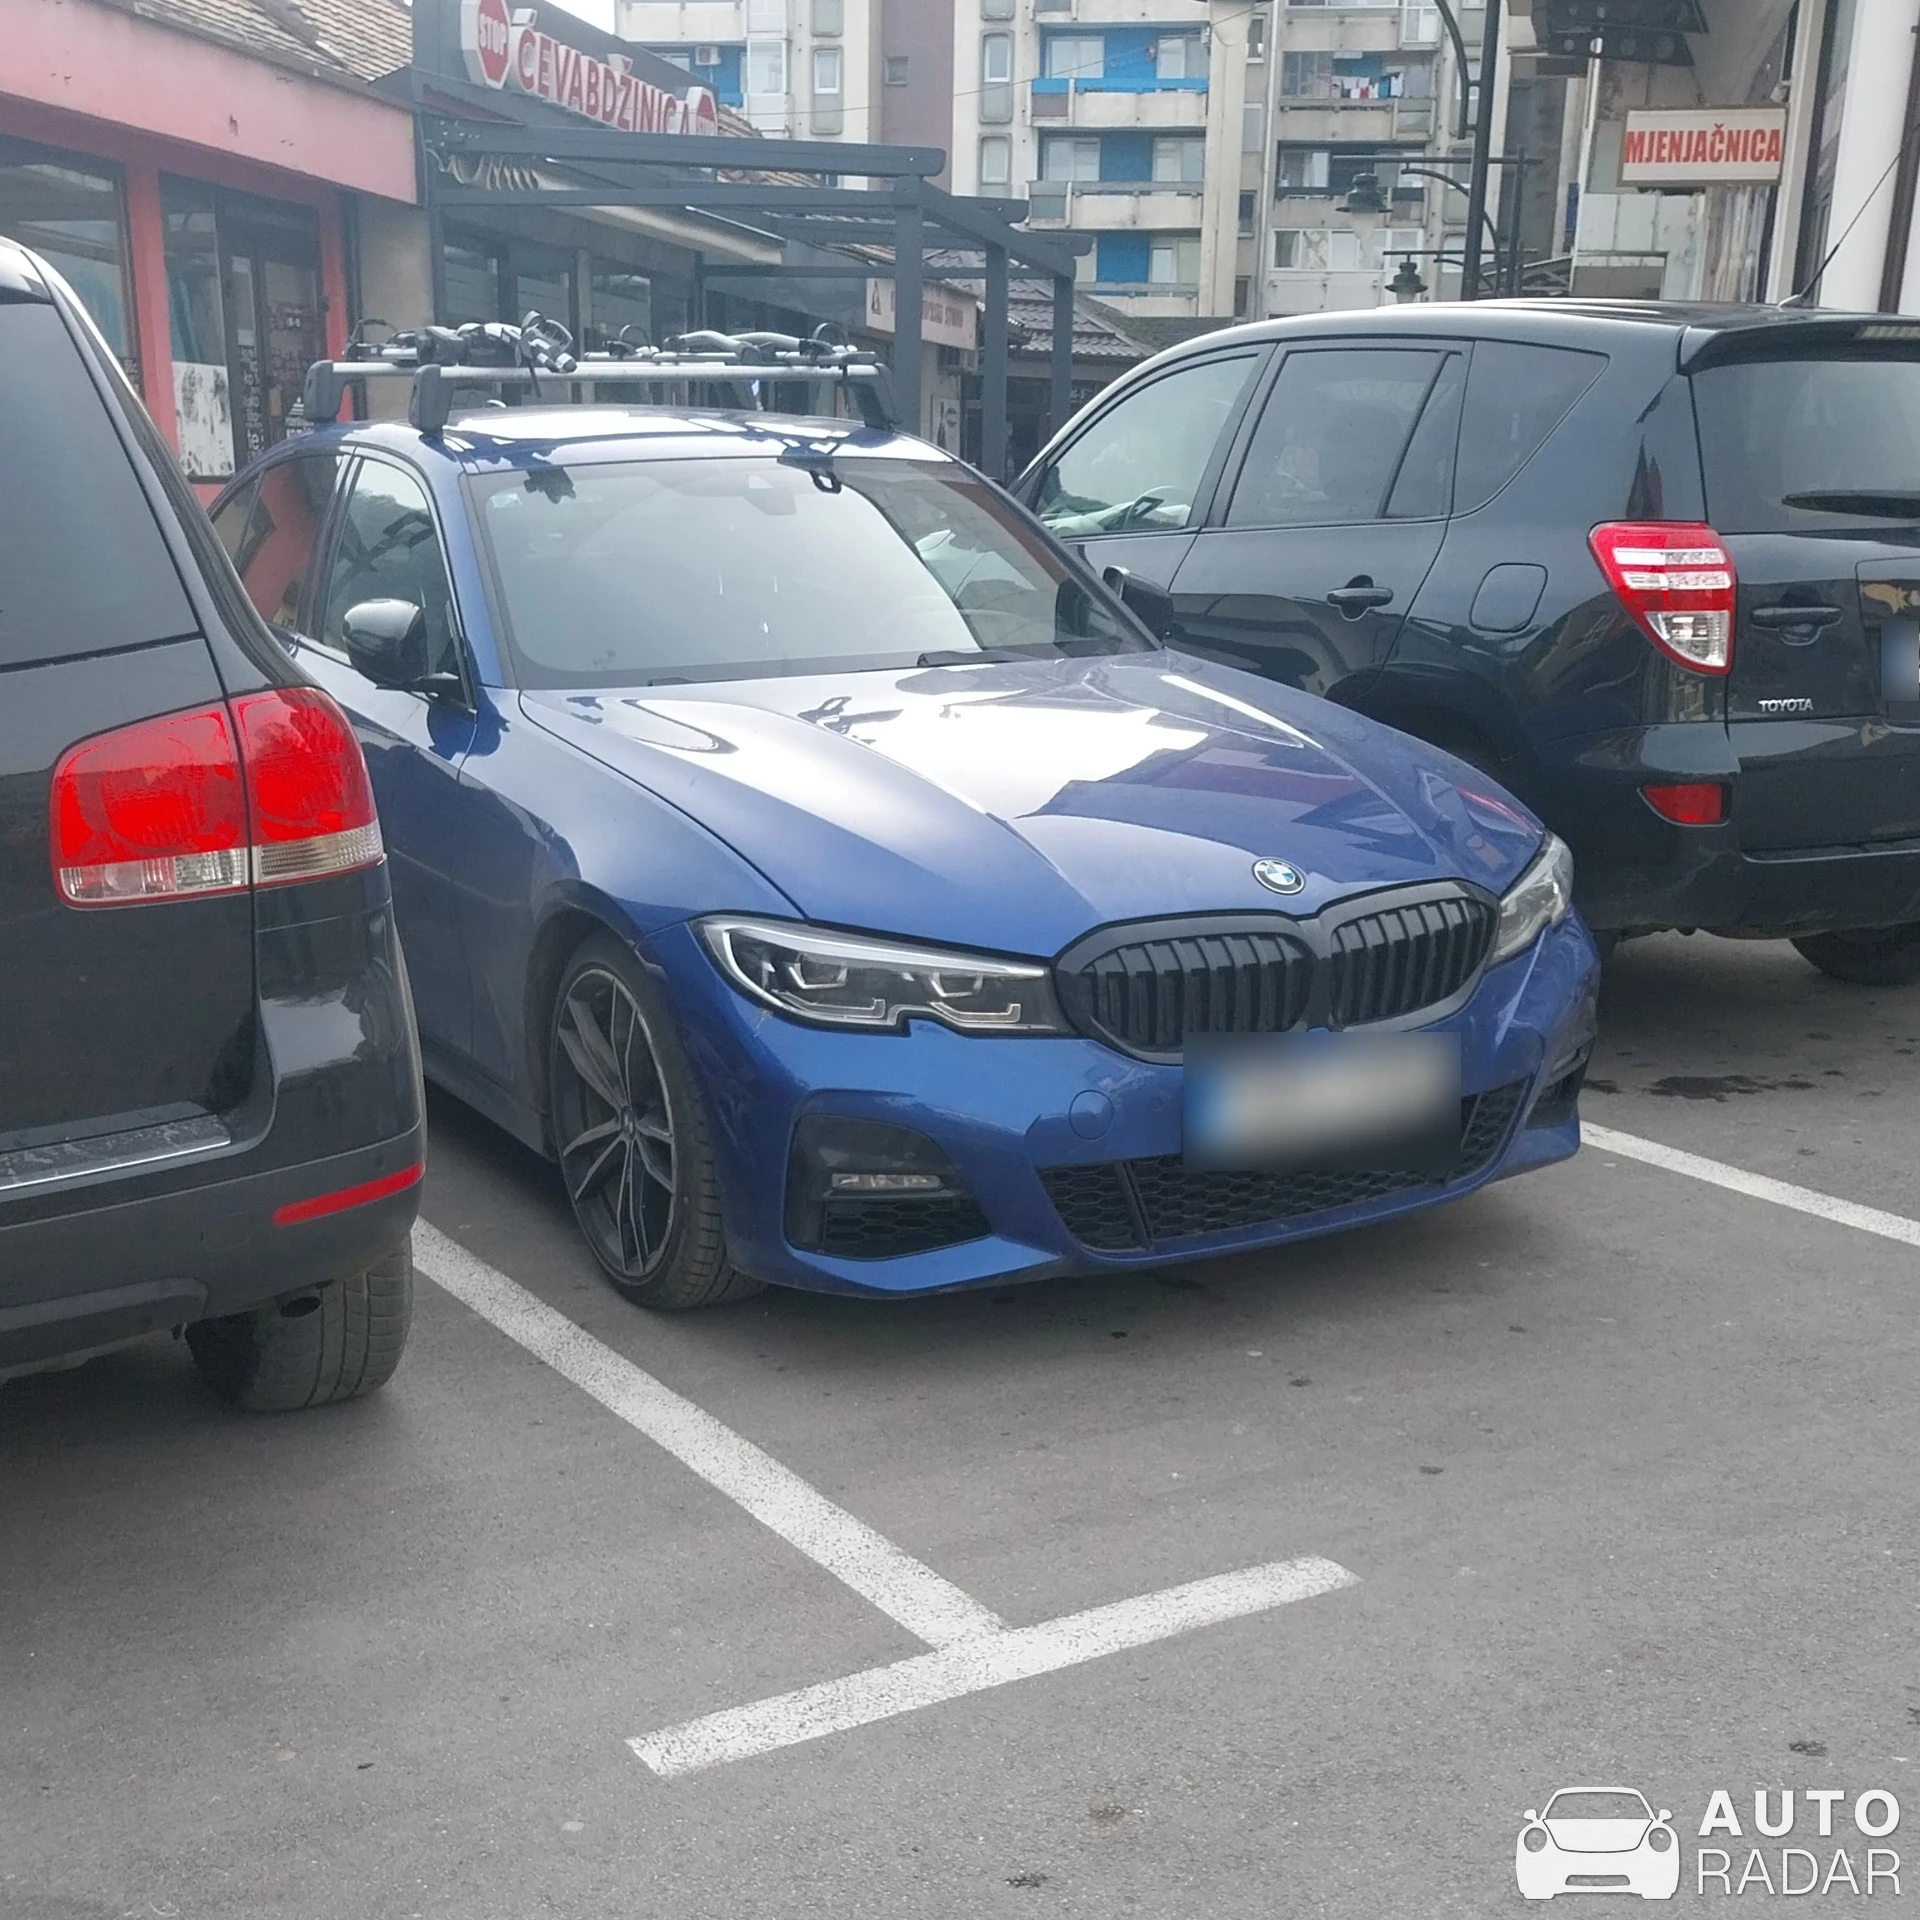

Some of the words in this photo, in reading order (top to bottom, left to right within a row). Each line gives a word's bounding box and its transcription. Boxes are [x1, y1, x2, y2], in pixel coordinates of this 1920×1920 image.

[479, 13, 507, 56] STOP
[512, 8, 690, 134] ČEVABDŽINICA
[1624, 123, 1780, 163] MJENJAČNICA
[1758, 698, 1814, 712] TOYOTA
